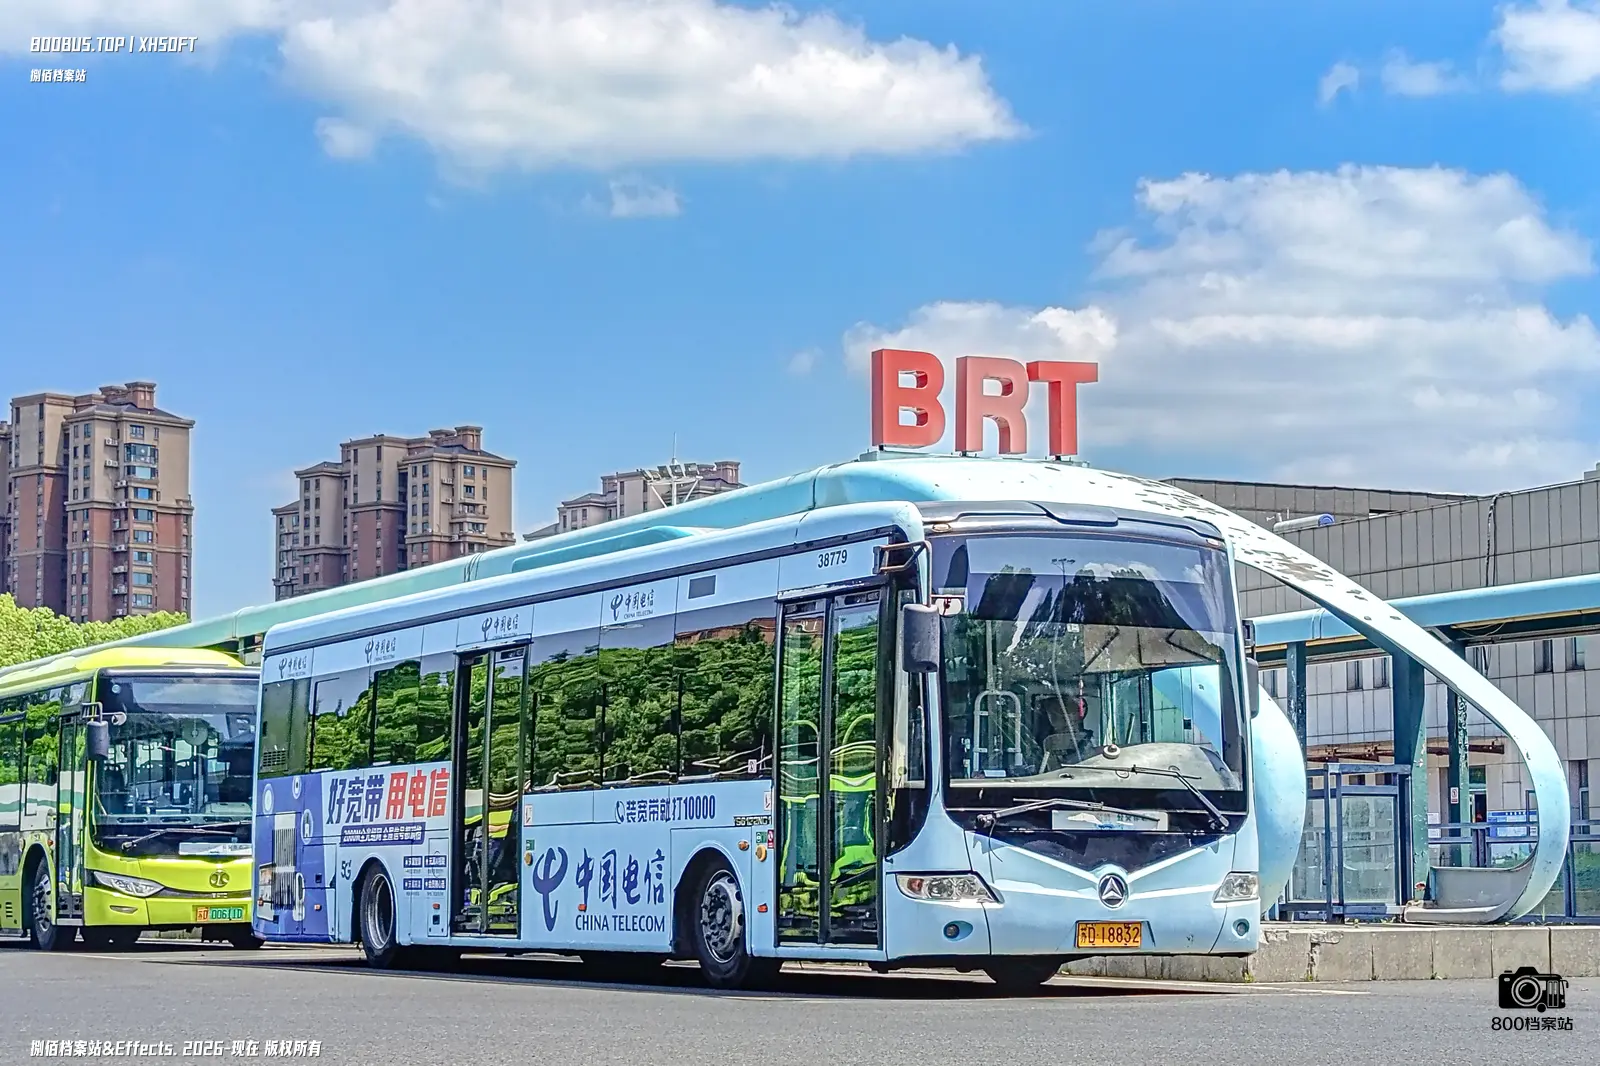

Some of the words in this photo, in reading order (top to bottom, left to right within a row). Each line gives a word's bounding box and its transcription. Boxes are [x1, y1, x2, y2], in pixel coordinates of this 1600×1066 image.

[872, 348, 1098, 456] BRT
[817, 549, 848, 568] 38779
[625, 589, 655, 612] 中国电信
[493, 614, 519, 634] 中国电信
[326, 768, 450, 825] 好宽带用电信
[626, 794, 716, 823] 装宽带就打10000
[575, 848, 665, 909] 中国电信
[575, 914, 610, 932] CHINA
[612, 915, 665, 933] TELECOM
